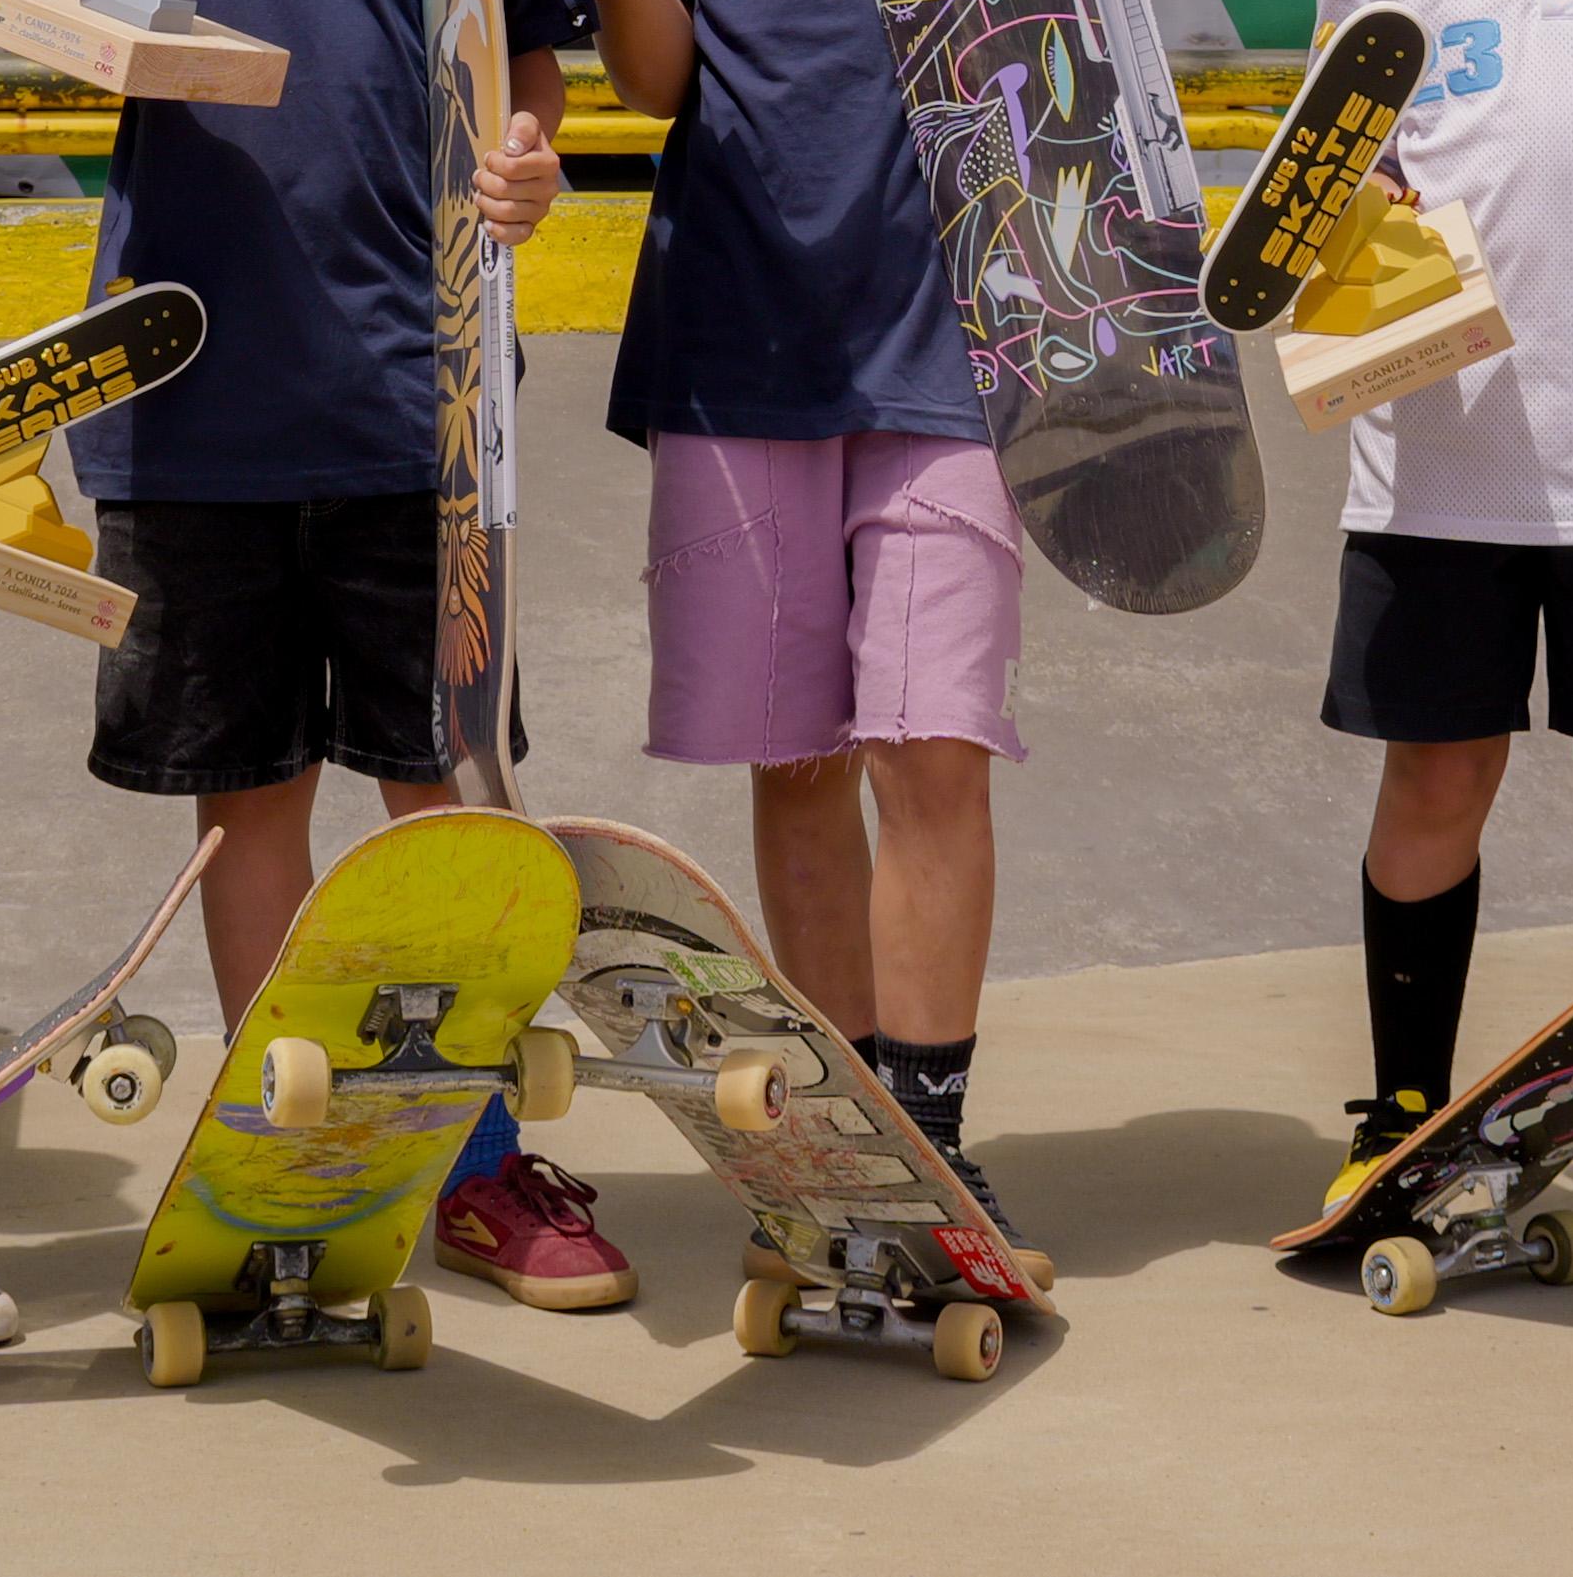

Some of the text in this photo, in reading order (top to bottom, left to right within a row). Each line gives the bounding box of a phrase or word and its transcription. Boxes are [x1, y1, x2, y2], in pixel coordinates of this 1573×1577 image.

[94, 61, 114, 76] CNS
[1260, 91, 1373, 267] SKATE
[1262, 126, 1318, 208] SUB 12
[1285, 102, 1397, 279] SERIES
[505, 264, 514, 294] Year
[504, 297, 515, 360] Warranty
[41, 342, 72, 367] 12
[1142, 337, 1217, 378] JART
[1417, 340, 1450, 360] 2026
[1467, 337, 1492, 355] CNS
[1426, 352, 1456, 369] Street
[90, 615, 113, 630] CNS
